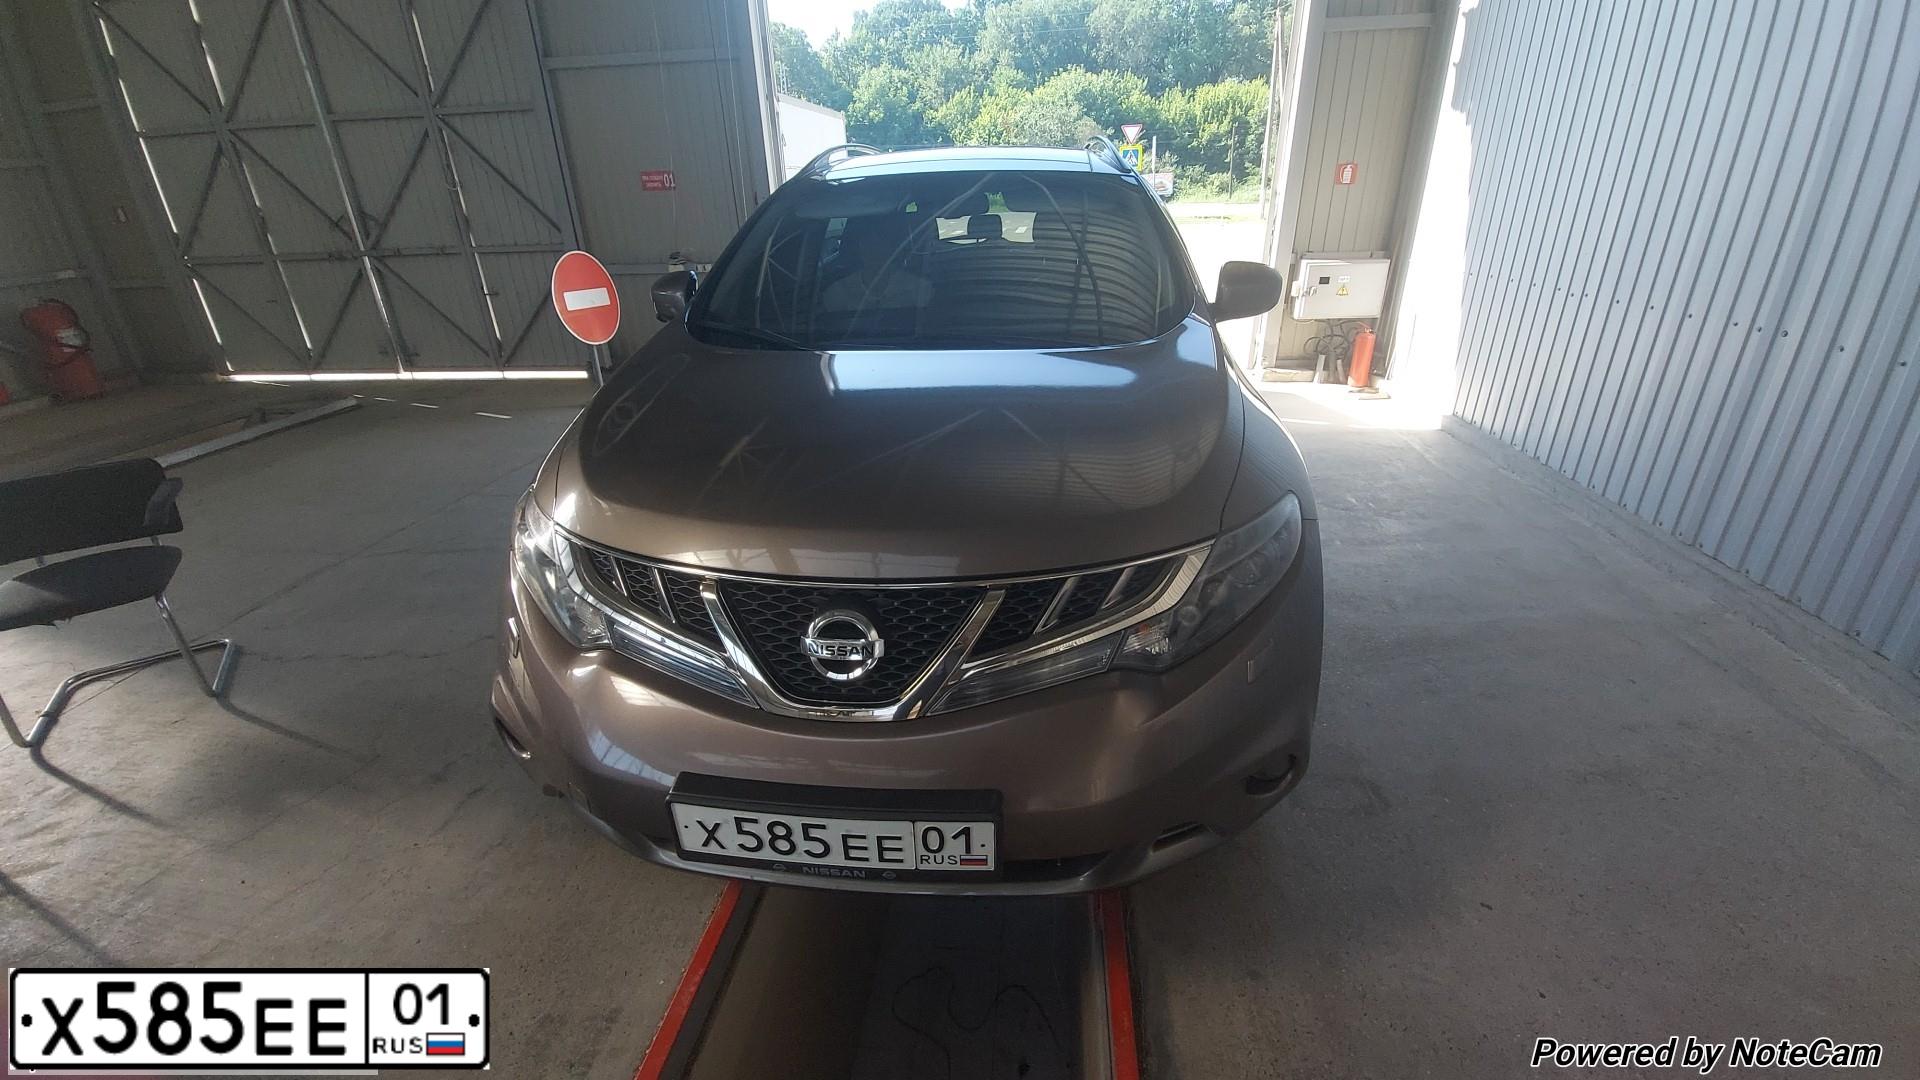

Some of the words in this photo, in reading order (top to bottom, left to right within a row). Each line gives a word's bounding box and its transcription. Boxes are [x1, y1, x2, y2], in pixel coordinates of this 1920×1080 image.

[663, 173, 676, 187] 01
[807, 639, 874, 658] NISSAN
[921, 826, 972, 854] 01
[920, 854, 958, 865] RUS
[802, 866, 866, 879] NISSAN
